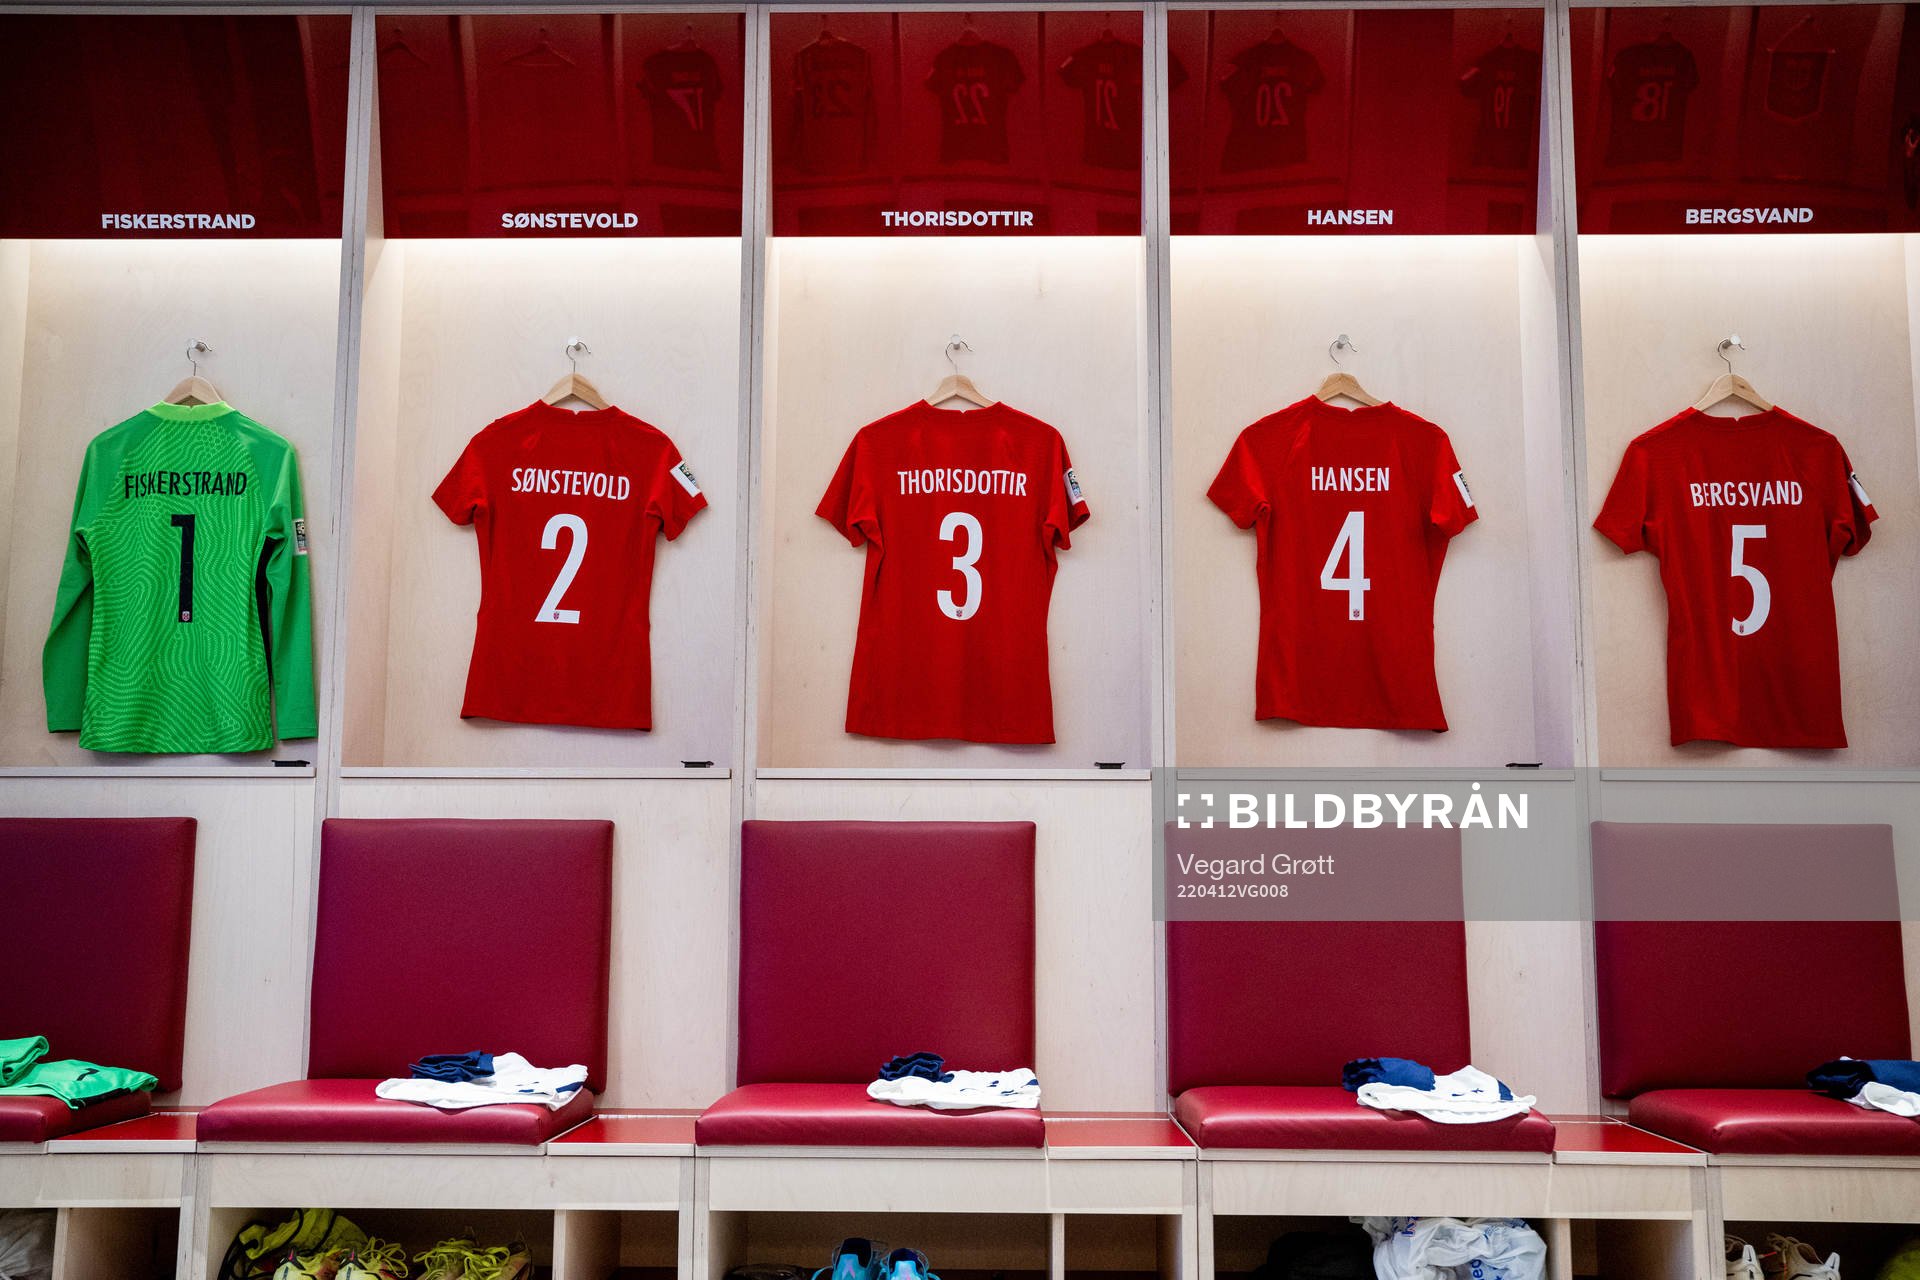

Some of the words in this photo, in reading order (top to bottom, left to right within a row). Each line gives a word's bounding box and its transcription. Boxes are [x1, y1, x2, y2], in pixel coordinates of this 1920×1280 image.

[101, 213, 256, 230] FISKERSTRAND
[501, 212, 639, 229] SØNSTEVOLD
[881, 210, 1035, 227] THORISDOTTIR
[1307, 209, 1394, 226] HANSEN
[1685, 207, 1814, 225] BERGSVAND
[124, 470, 248, 500] FISKERSTRAND
[511, 467, 631, 501] SØNSTEVOLD
[897, 467, 1028, 498] THORISDOTTIR
[1311, 466, 1390, 492] HANSEN
[1689, 480, 1803, 508] BERGSVAND
[170, 513, 196, 624] 1
[533, 513, 589, 625] 2
[936, 511, 984, 621] 3
[1319, 510, 1371, 621] 4
[1730, 524, 1771, 637] 5
